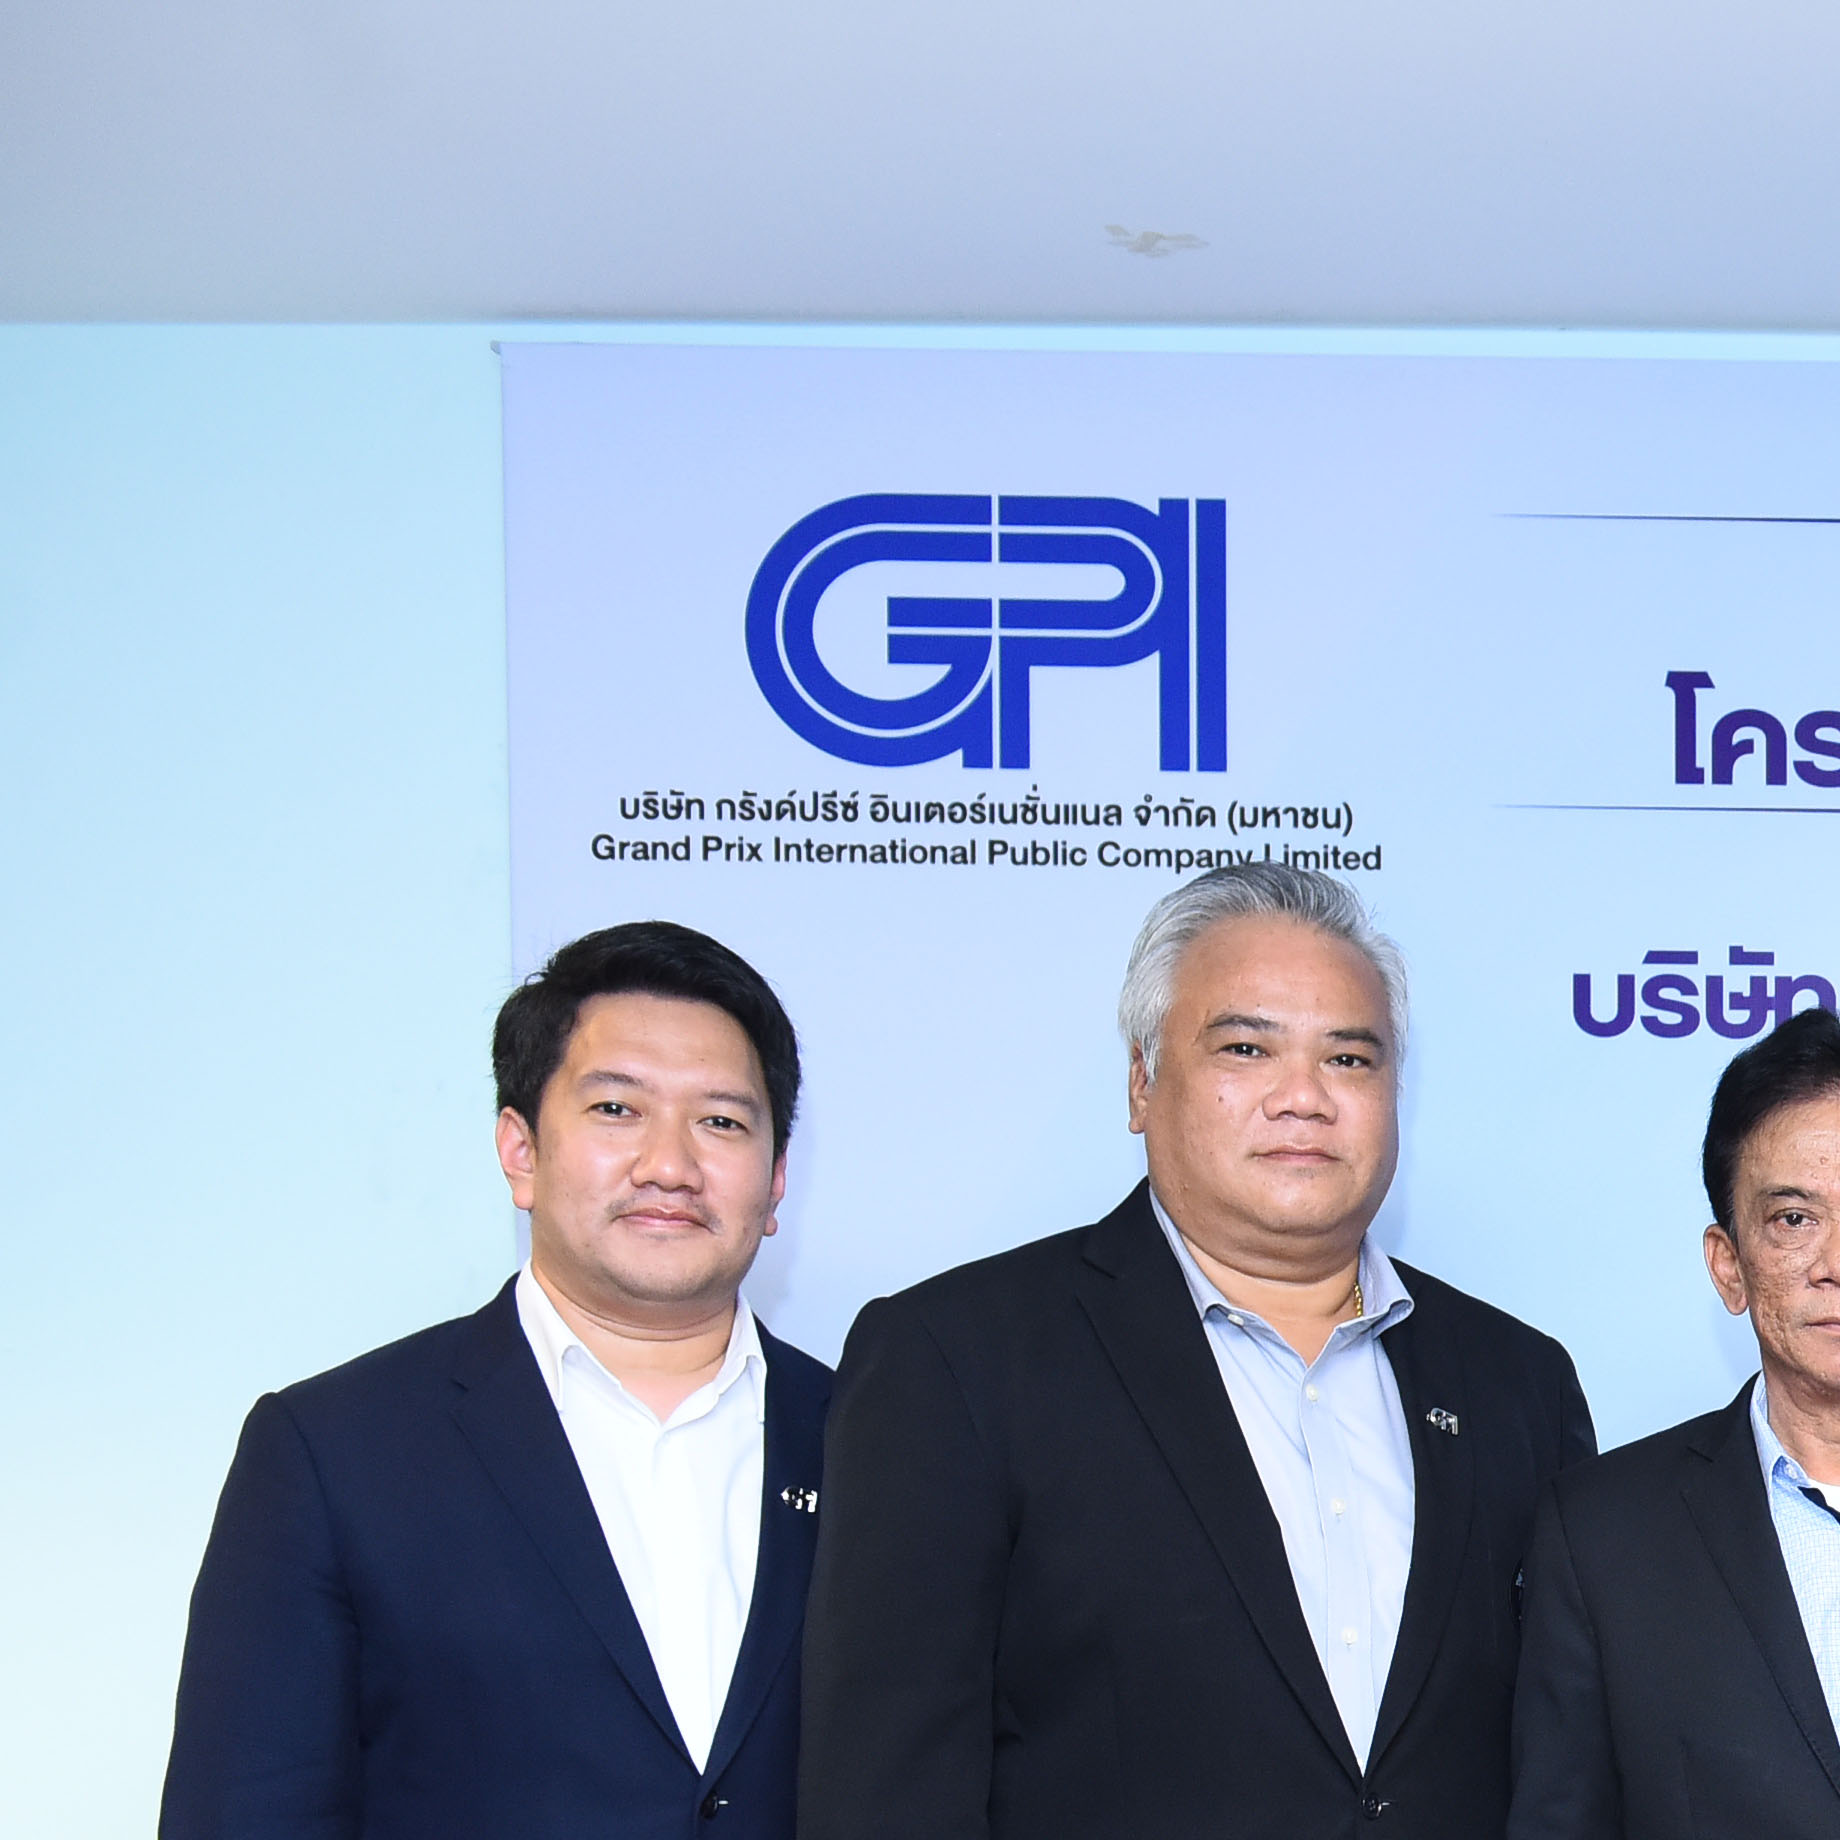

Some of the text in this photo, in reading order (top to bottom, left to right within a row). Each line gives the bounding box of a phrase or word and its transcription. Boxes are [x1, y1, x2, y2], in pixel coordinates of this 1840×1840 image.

[745, 493, 1228, 772] GPI
[620, 784, 1353, 837] บริษัท กรังด์ปรีซ์ อินเตอร์เนชั่นแนล จำกัด (มหาชน)
[591, 833, 691, 862] Grand
[702, 835, 763, 862] Prix
[774, 836, 977, 865] International
[988, 839, 1087, 867] Public
